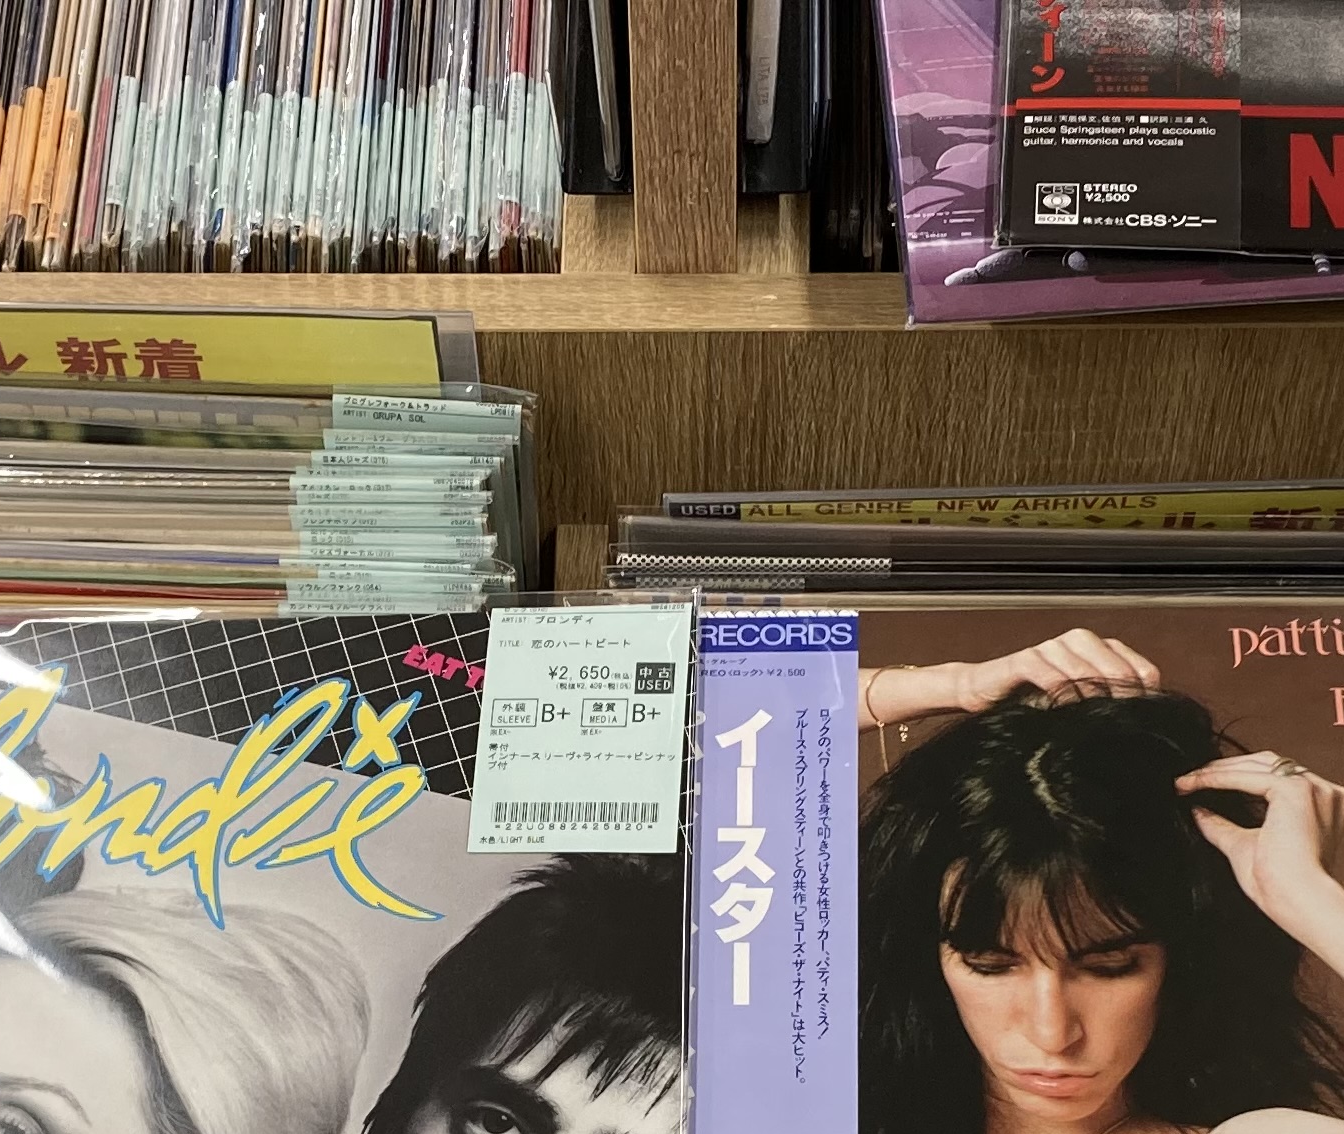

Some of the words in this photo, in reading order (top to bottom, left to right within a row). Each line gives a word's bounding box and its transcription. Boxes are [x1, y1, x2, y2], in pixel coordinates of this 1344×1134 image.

[1030, 0, 1067, 93] ィーン
[1023, 126, 1057, 135] Bruce
[1060, 126, 1126, 136] Springsteen
[1129, 126, 1158, 136] plays
[1162, 126, 1217, 136] accoustic
[1023, 137, 1057, 147] guitar,
[1061, 137, 1119, 146] harmonica
[1122, 137, 1144, 146] and
[1147, 138, 1184, 147] vocals
[1040, 186, 1076, 194] CBS
[1083, 183, 1138, 193] STEREO
[1085, 193, 1131, 203] ¥2,500
[1037, 215, 1076, 223] SONY
[56, 337, 204, 383] 新着
[409, 414, 426, 423] SOL
[681, 504, 737, 517] USED
[748, 503, 802, 517] ALL
[815, 502, 914, 516] GENRE
[1012, 496, 1157, 511] ARRIVALS
[535, 615, 595, 625] ブロンディ
[700, 622, 853, 648] RECORDS
[530, 638, 632, 650] 恋のハートビート
[402, 644, 467, 681] EAT
[465, 665, 486, 689] T
[638, 666, 672, 680] 中古
[637, 679, 672, 692] USED
[592, 702, 616, 713] 盤質
[541, 703, 571, 724] B+
[632, 703, 662, 724] B+
[497, 715, 532, 724] SLEEVE
[589, 715, 619, 724] MEDIA
[527, 836, 545, 845] BLUE
[710, 708, 777, 1006] イースター
